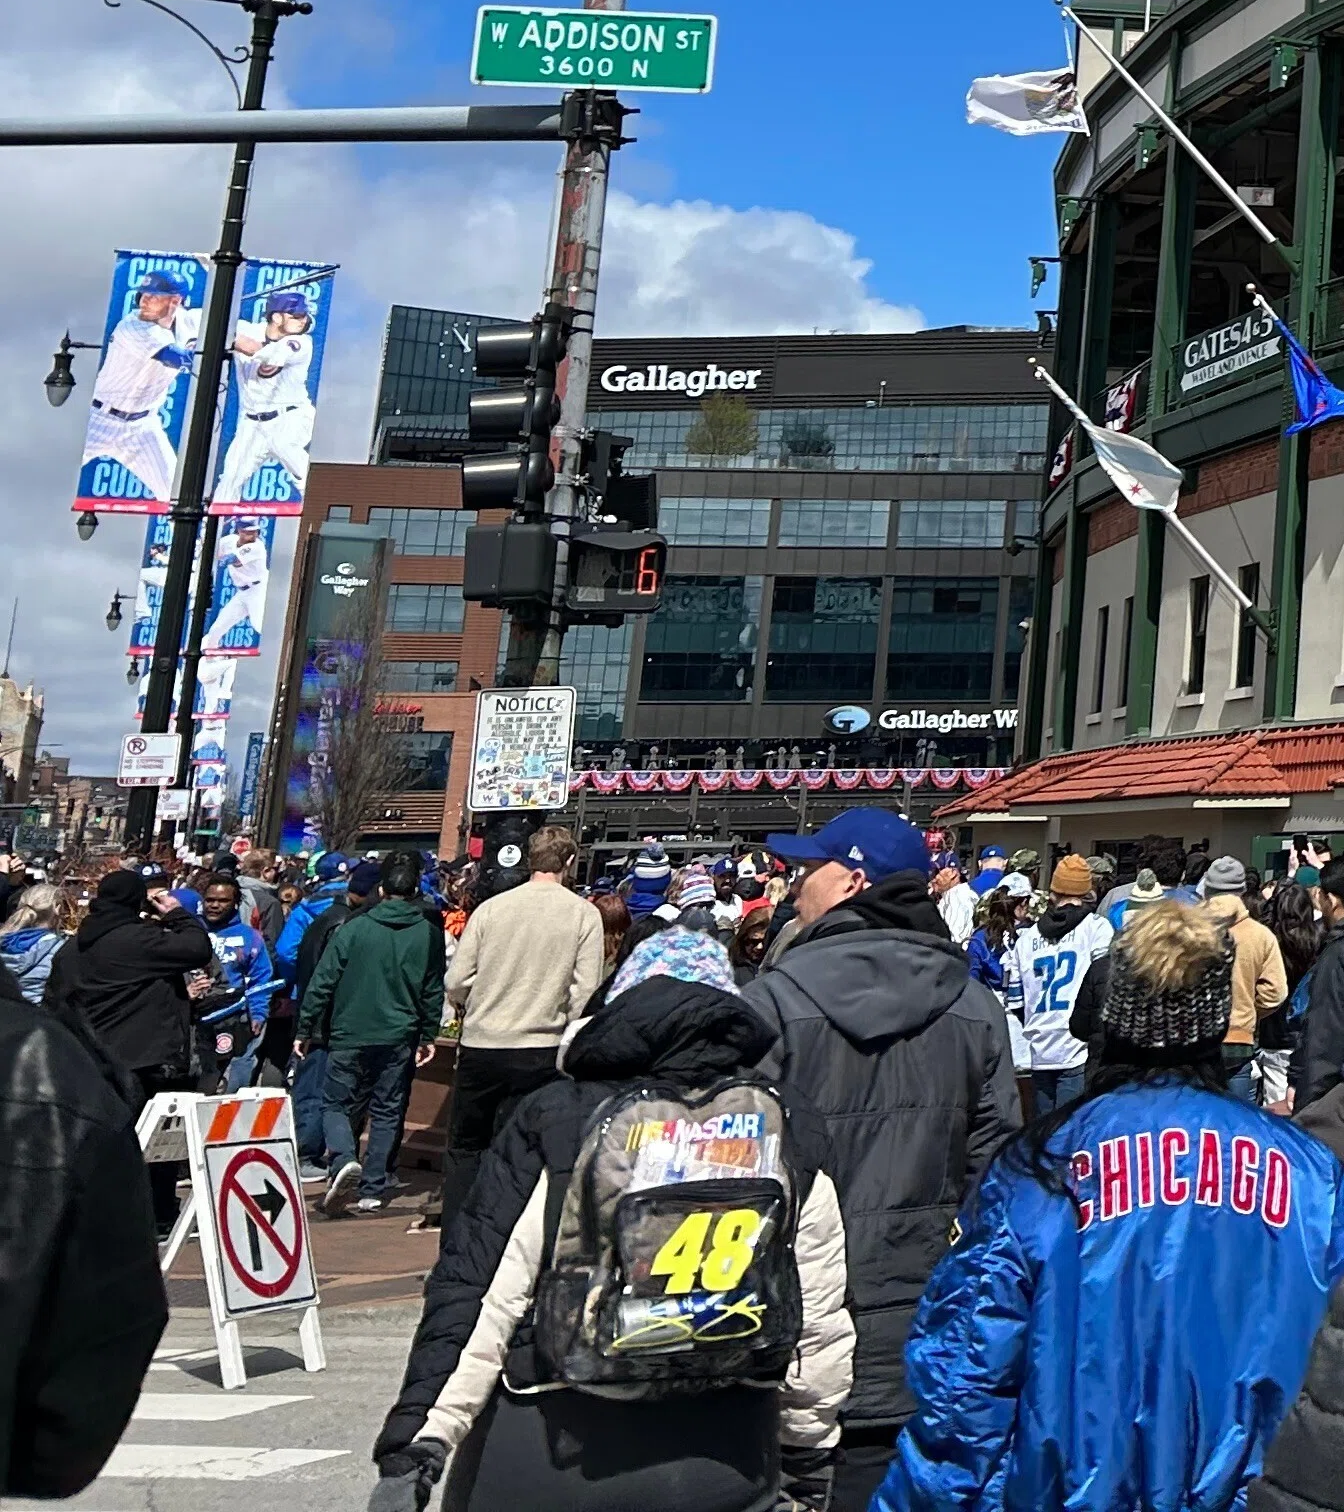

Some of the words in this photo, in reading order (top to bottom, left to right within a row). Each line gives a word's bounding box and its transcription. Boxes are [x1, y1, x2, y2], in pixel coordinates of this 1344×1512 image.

[491, 22, 508, 43] W
[518, 19, 665, 53] ADDISON
[675, 30, 702, 51] ST
[539, 56, 613, 77] 3600
[631, 59, 648, 78] N
[1184, 322, 1242, 368] GATES
[600, 364, 762, 398] Gallagher
[242, 467, 294, 502] UBS
[320, 574, 369, 587] Gallagher
[637, 549, 657, 596] 6
[333, 584, 355, 597] Way
[879, 710, 991, 733] Gallagher
[672, 1113, 759, 1145] NASCAR
[1071, 1127, 1291, 1233] CHICAGO
[650, 1208, 761, 1295] 48
